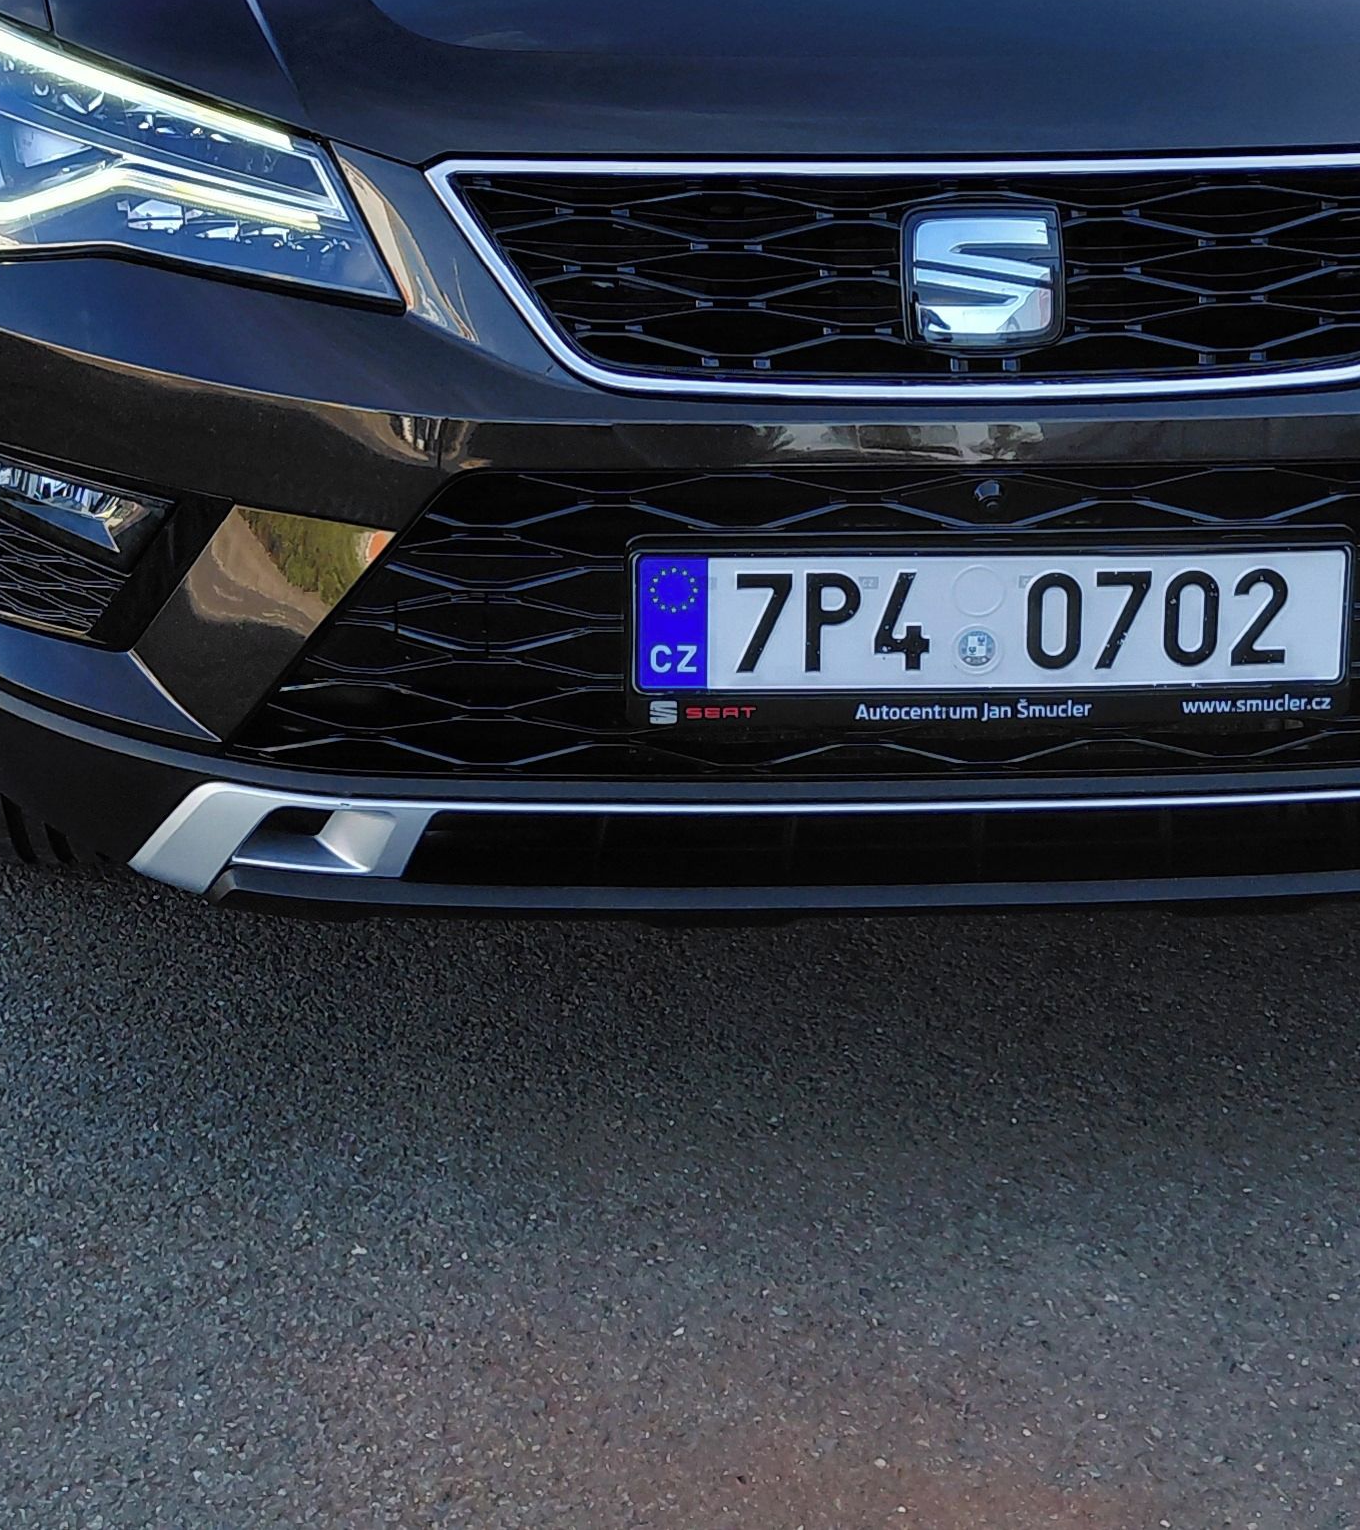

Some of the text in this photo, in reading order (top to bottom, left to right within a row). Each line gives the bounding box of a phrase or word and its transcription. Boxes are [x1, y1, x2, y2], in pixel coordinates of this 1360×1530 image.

[736, 568, 1288, 673] 7P4 0702
[650, 645, 698, 673] CZ
[686, 707, 757, 719] SEAT
[855, 699, 1092, 722] Autocentrum Jan Šmucler
[1182, 694, 1332, 714] www.smucler.cz
